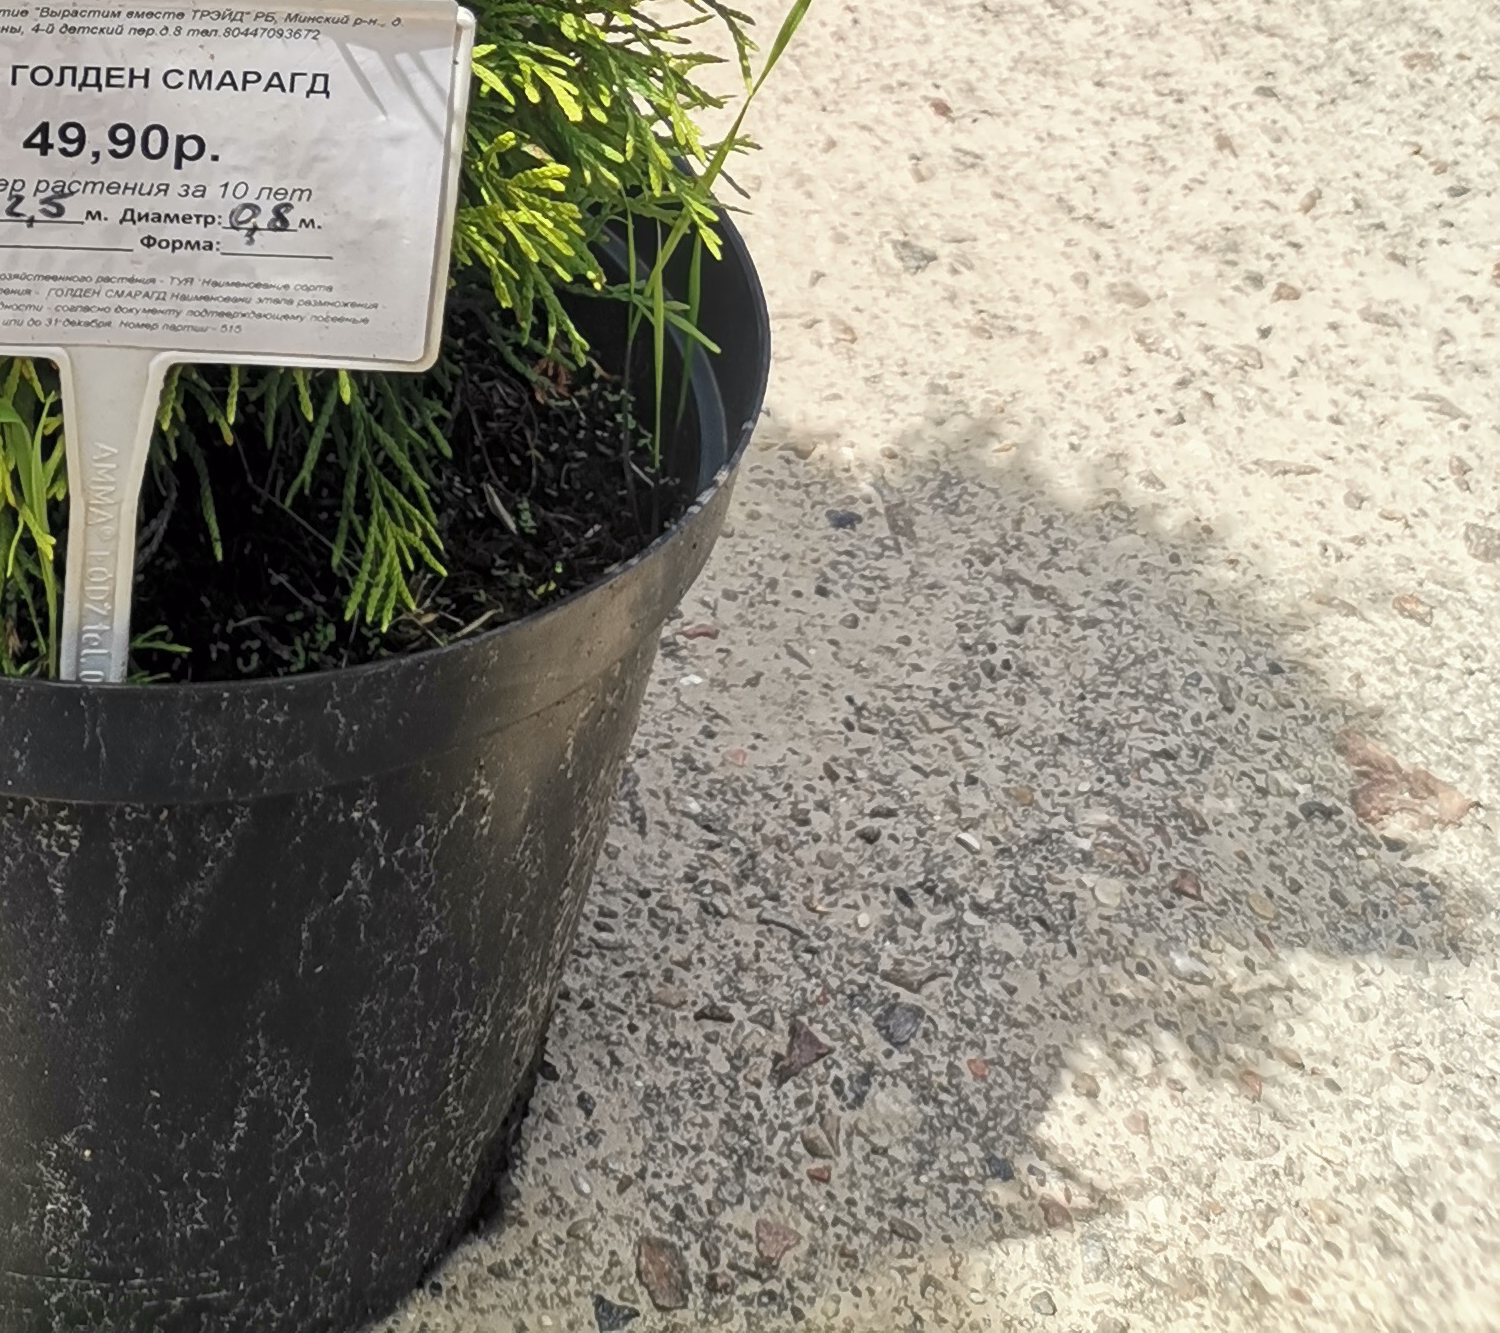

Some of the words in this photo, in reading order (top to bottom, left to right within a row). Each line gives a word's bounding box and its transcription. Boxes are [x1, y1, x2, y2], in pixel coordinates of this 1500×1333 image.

[125, 10, 186, 21] вместе
[191, 8, 251, 23] ТРЭЙД"
[253, 12, 278, 25] РБ,
[284, 12, 349, 26] Минский
[31, 22, 55, 35] 4-й
[58, 23, 124, 36] детский
[10, 64, 151, 93] ГОЛДЕН
[161, 67, 332, 100] СМАРАГД
[21, 120, 221, 171] 49,90р.
[32, 177, 170, 198] растения
[177, 183, 208, 200] за
[219, 180, 250, 201] 10
[254, 185, 313, 203] лет
[84, 209, 109, 222] м.
[118, 207, 223, 228] Диаметр:
[297, 217, 323, 231] м.
[139, 234, 221, 254] Форма:
[169, 274, 195, 286] ТУЯ
[46, 286, 101, 299] ГОЛДЕН
[104, 288, 168, 302] СМАРАГД
[1, 318, 25, 328] или
[26, 317, 43, 328] до
[118, 319, 160, 331] Номер
